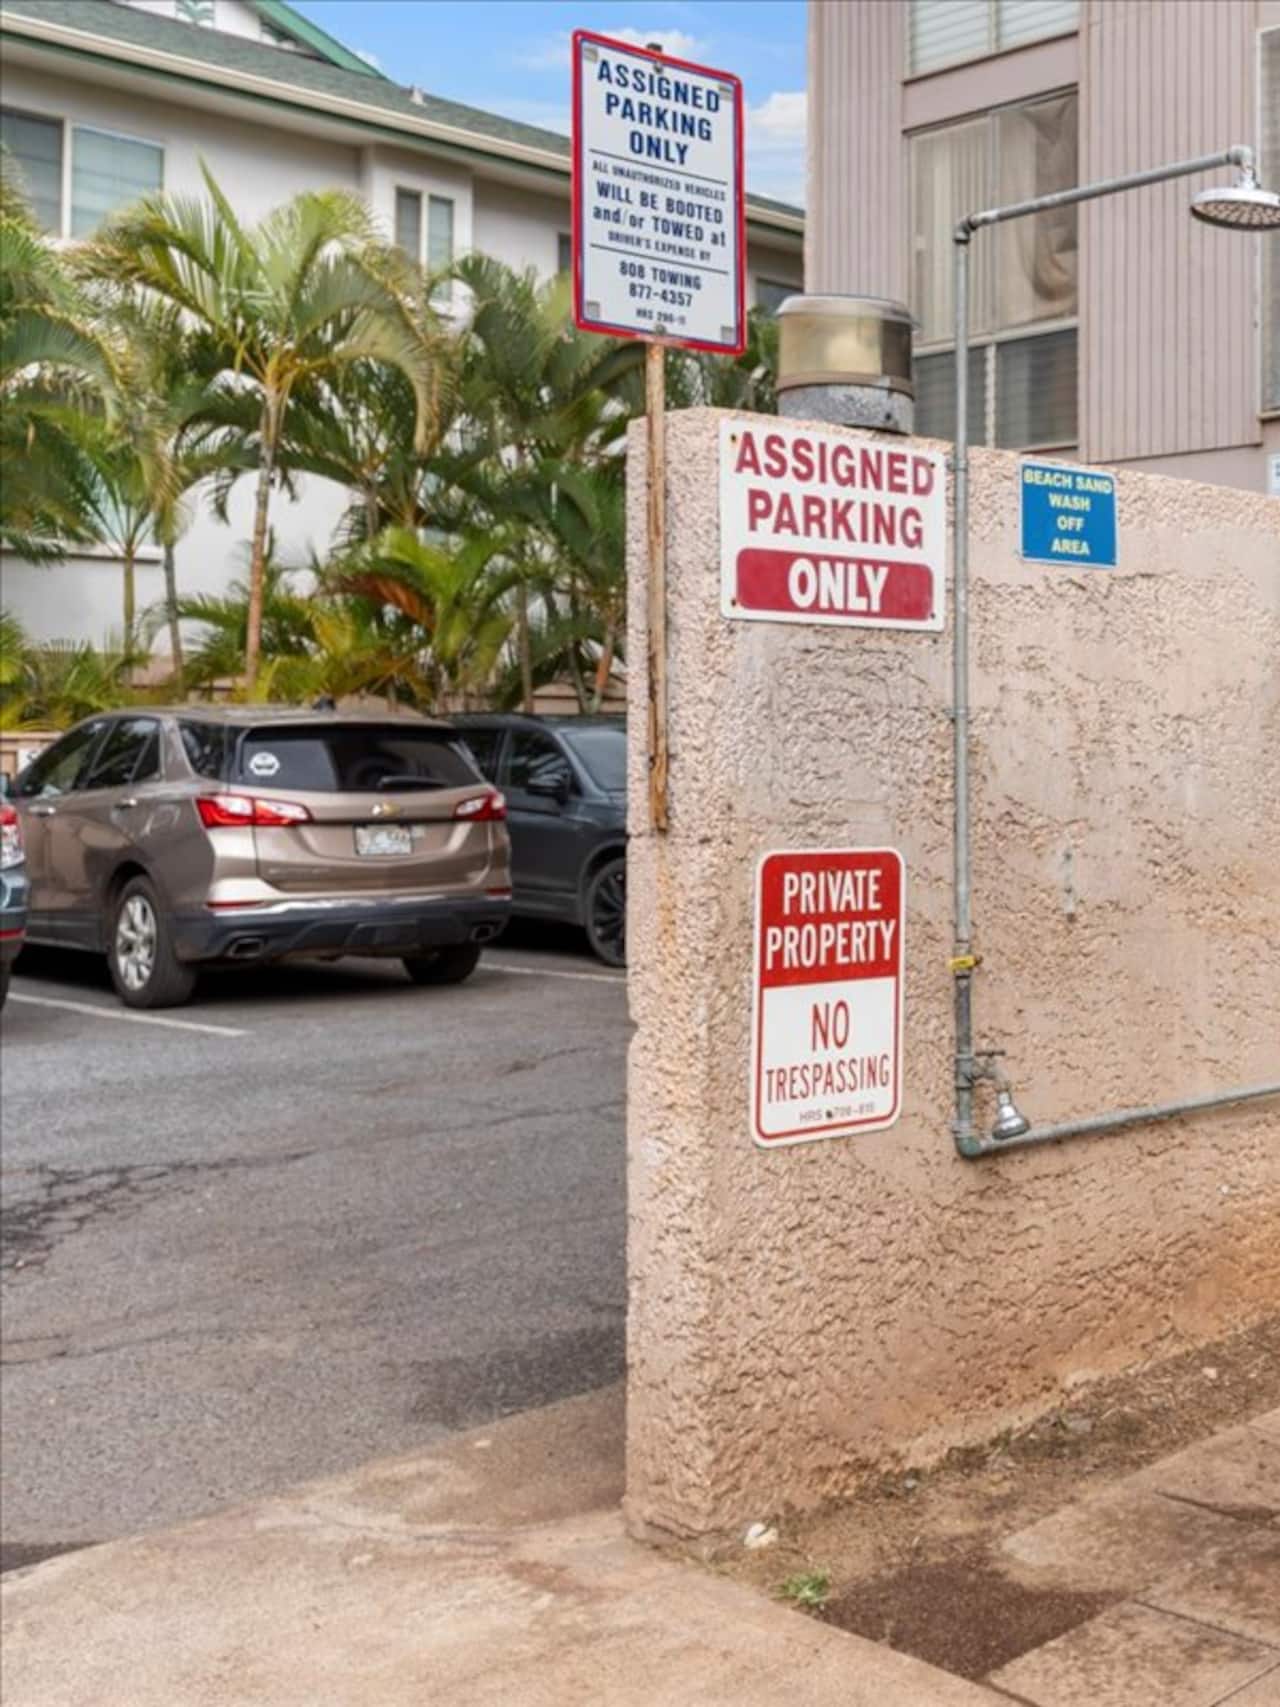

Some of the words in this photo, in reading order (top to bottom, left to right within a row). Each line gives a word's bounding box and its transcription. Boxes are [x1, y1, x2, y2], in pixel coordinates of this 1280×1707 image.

[598, 59, 720, 113] ASSIGNED
[606, 92, 712, 141] PARKING
[629, 130, 689, 165] ONLY
[592, 161, 608, 173] ALL
[612, 165, 681, 191] UNAUTHORIZED
[685, 183, 726, 201] VEHICLES
[596, 180, 633, 204] WILL
[640, 191, 658, 210] BE
[666, 198, 723, 224] BOOTED
[593, 206, 644, 229] and/or
[651, 216, 704, 242] TOWED
[710, 232, 726, 247] at
[608, 230, 651, 249] DRIVER'S
[654, 240, 696, 259] EXPENSE
[699, 250, 711, 261] BY
[620, 261, 646, 279] 808
[652, 267, 702, 290] TOWING
[629, 282, 693, 307] 877-4357
[735, 431, 934, 496] ASSIGNED
[1023, 469, 1073, 489] BEACH
[1075, 475, 1113, 495] SAND
[748, 488, 923, 549] PARKING
[1047, 492, 1091, 512] WASH
[1056, 515, 1085, 532] OFF
[1051, 537, 1091, 556] AREA
[788, 557, 889, 612] ONLY
[783, 869, 882, 915] PRIVATE
[766, 919, 896, 970] PROPERTY
[812, 1000, 849, 1051] NO
[766, 1053, 889, 1103] TRESPASSING
